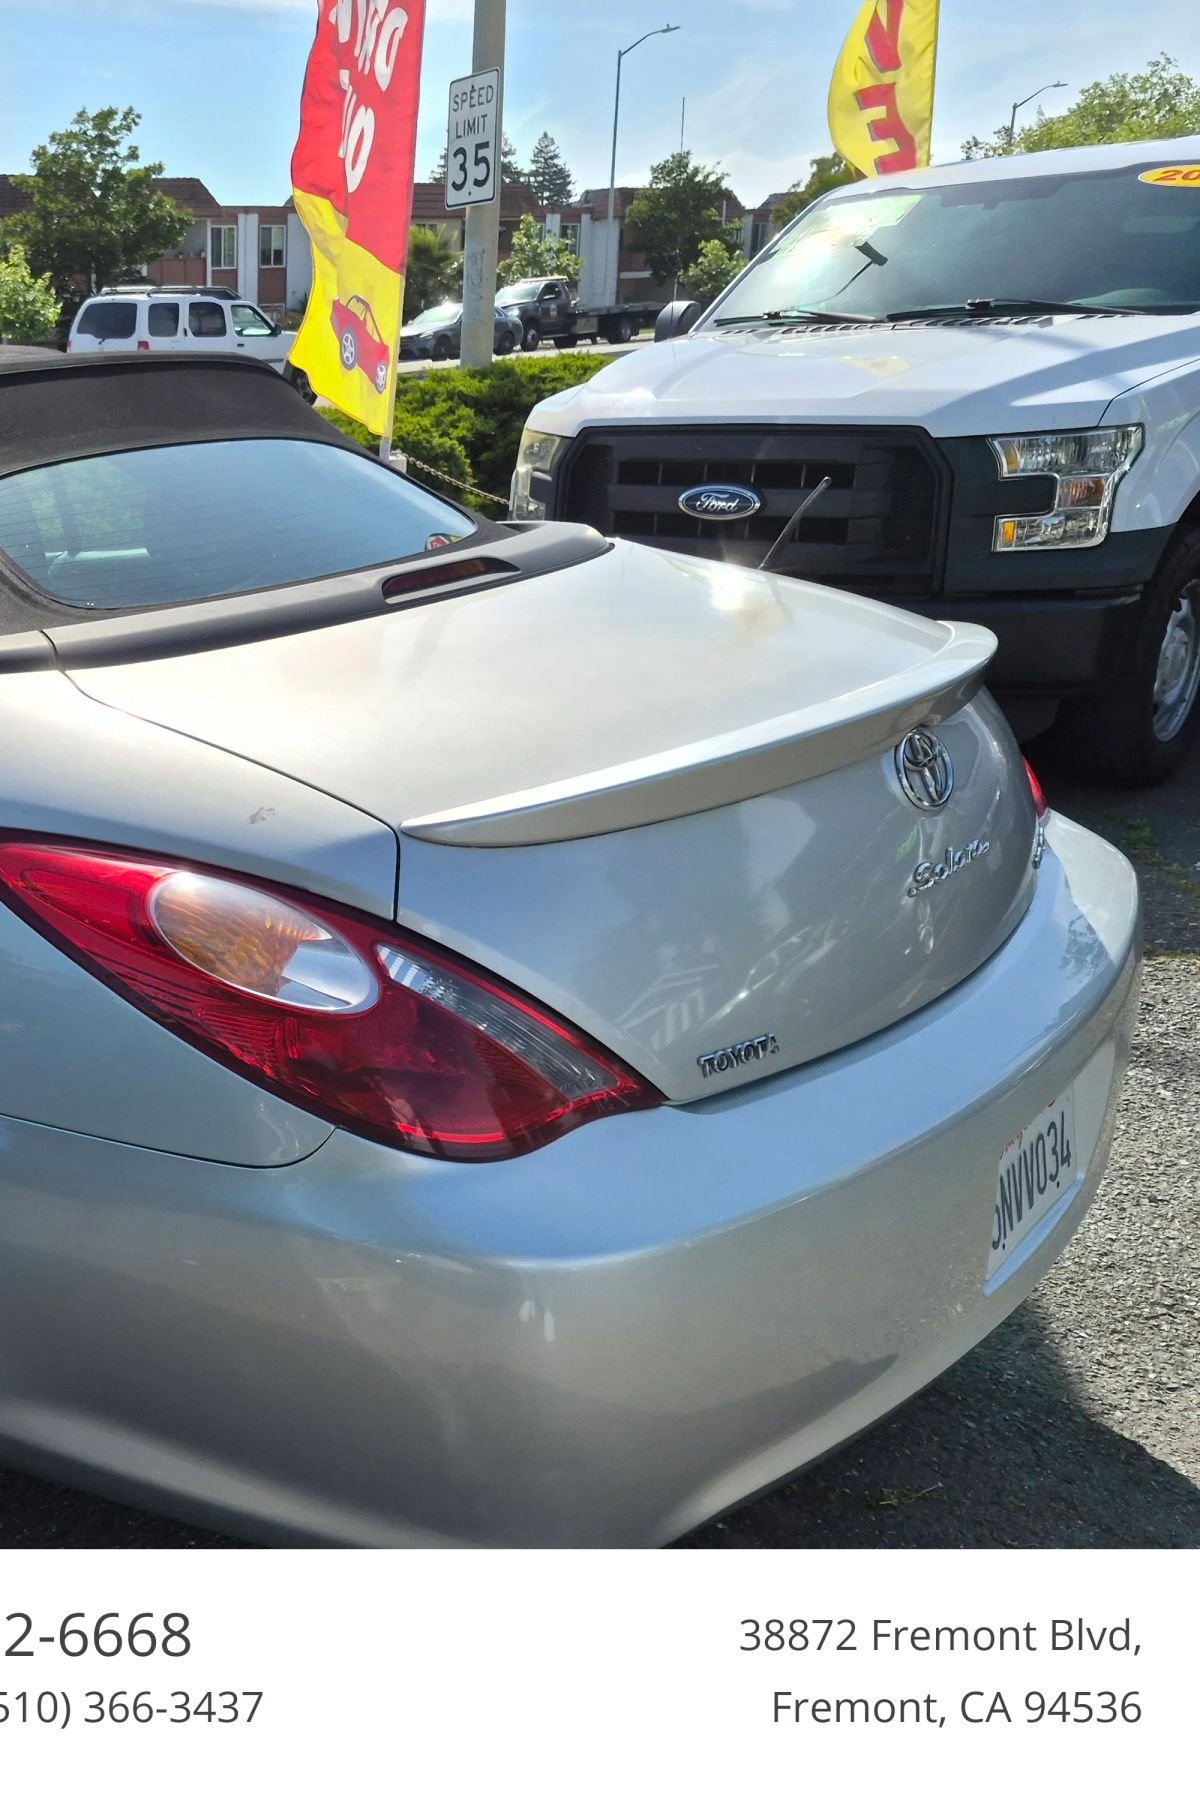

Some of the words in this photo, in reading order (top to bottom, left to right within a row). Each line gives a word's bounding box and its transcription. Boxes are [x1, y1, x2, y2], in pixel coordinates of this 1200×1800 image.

[452, 85, 494, 113] SPEED
[455, 114, 488, 139] LIMIT
[451, 141, 490, 192] 35
[695, 492, 740, 512] Ford
[696, 1033, 780, 1078] TOYOTA
